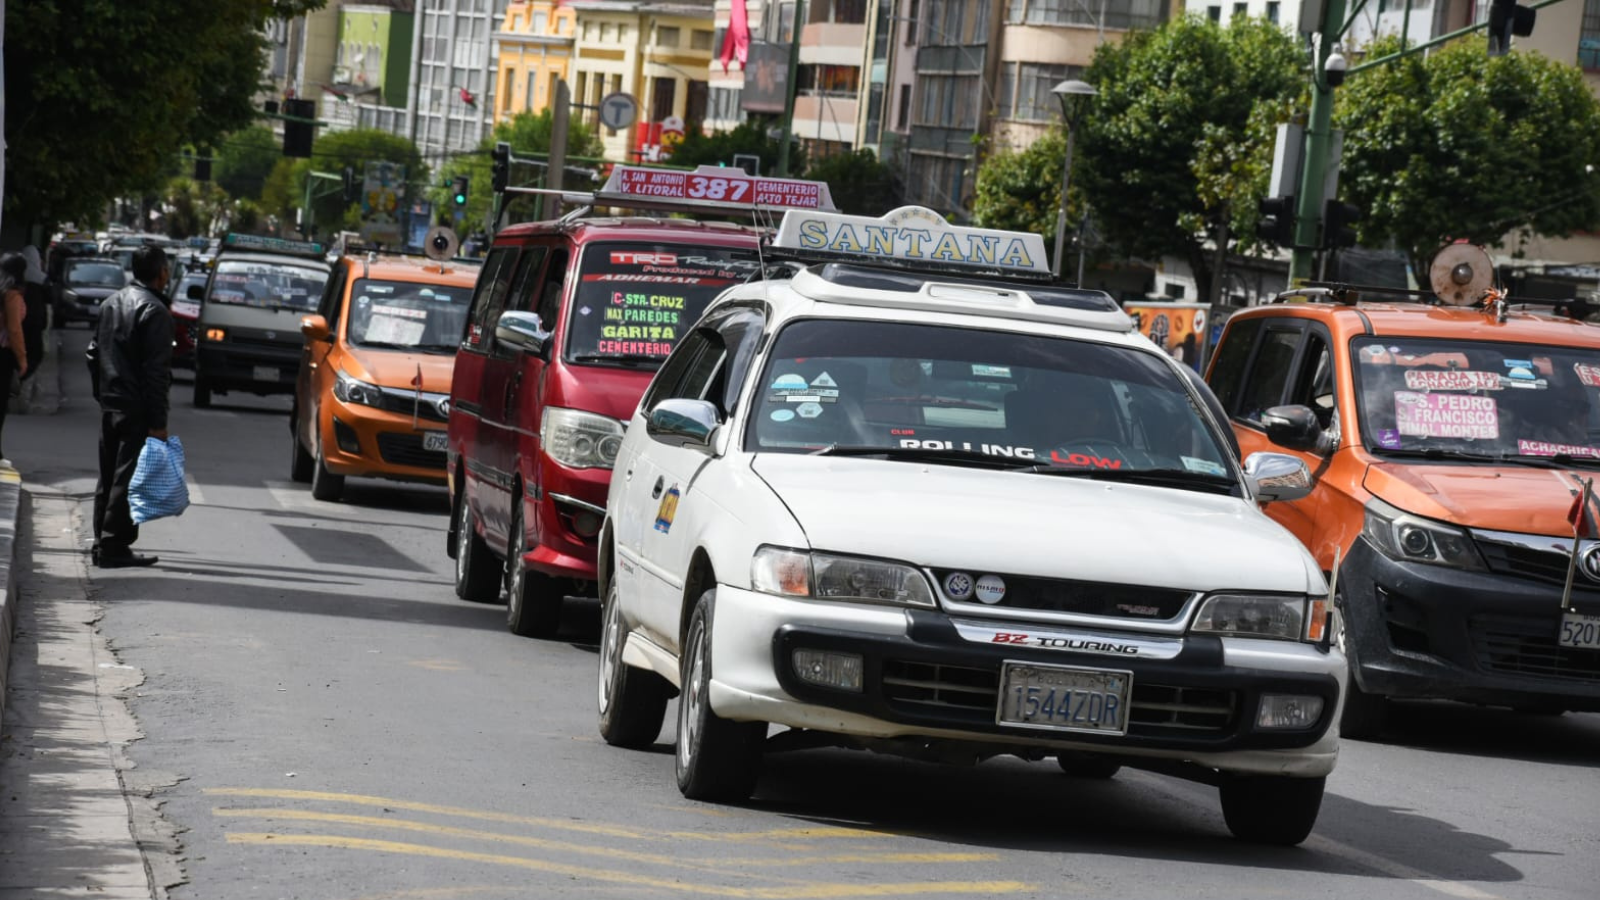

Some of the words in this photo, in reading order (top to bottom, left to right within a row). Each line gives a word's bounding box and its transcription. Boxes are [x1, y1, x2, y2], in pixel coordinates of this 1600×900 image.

[631, 172, 646, 182] SAN
[651, 173, 684, 185] ANTONIO
[622, 183, 631, 192] V.
[635, 185, 684, 197] LITORAL
[688, 177, 750, 200] 387
[757, 182, 818, 195] CEMENTERIO
[785, 195, 817, 207] TEJAR
[799, 219, 1035, 268] SANTANA
[610, 252, 678, 265] TRD
[643, 265, 715, 277] Produced
[598, 273, 701, 285] ADHEMAR
[650, 295, 684, 309] CRUZ
[624, 309, 678, 324] PAREDES
[603, 325, 675, 339] GARITA
[599, 340, 671, 355] CEMENTERIO
[1407, 371, 1470, 381] PARADA
[1438, 396, 1494, 411] PEDRO
[1415, 408, 1496, 425] FRANCISCO
[1399, 422, 1437, 436] FINAL
[1440, 424, 1498, 439] MONTES
[1050, 451, 1122, 470] LOW
[1036, 637, 1140, 655] TOURING
[1014, 686, 1120, 725] 1544ZDR
